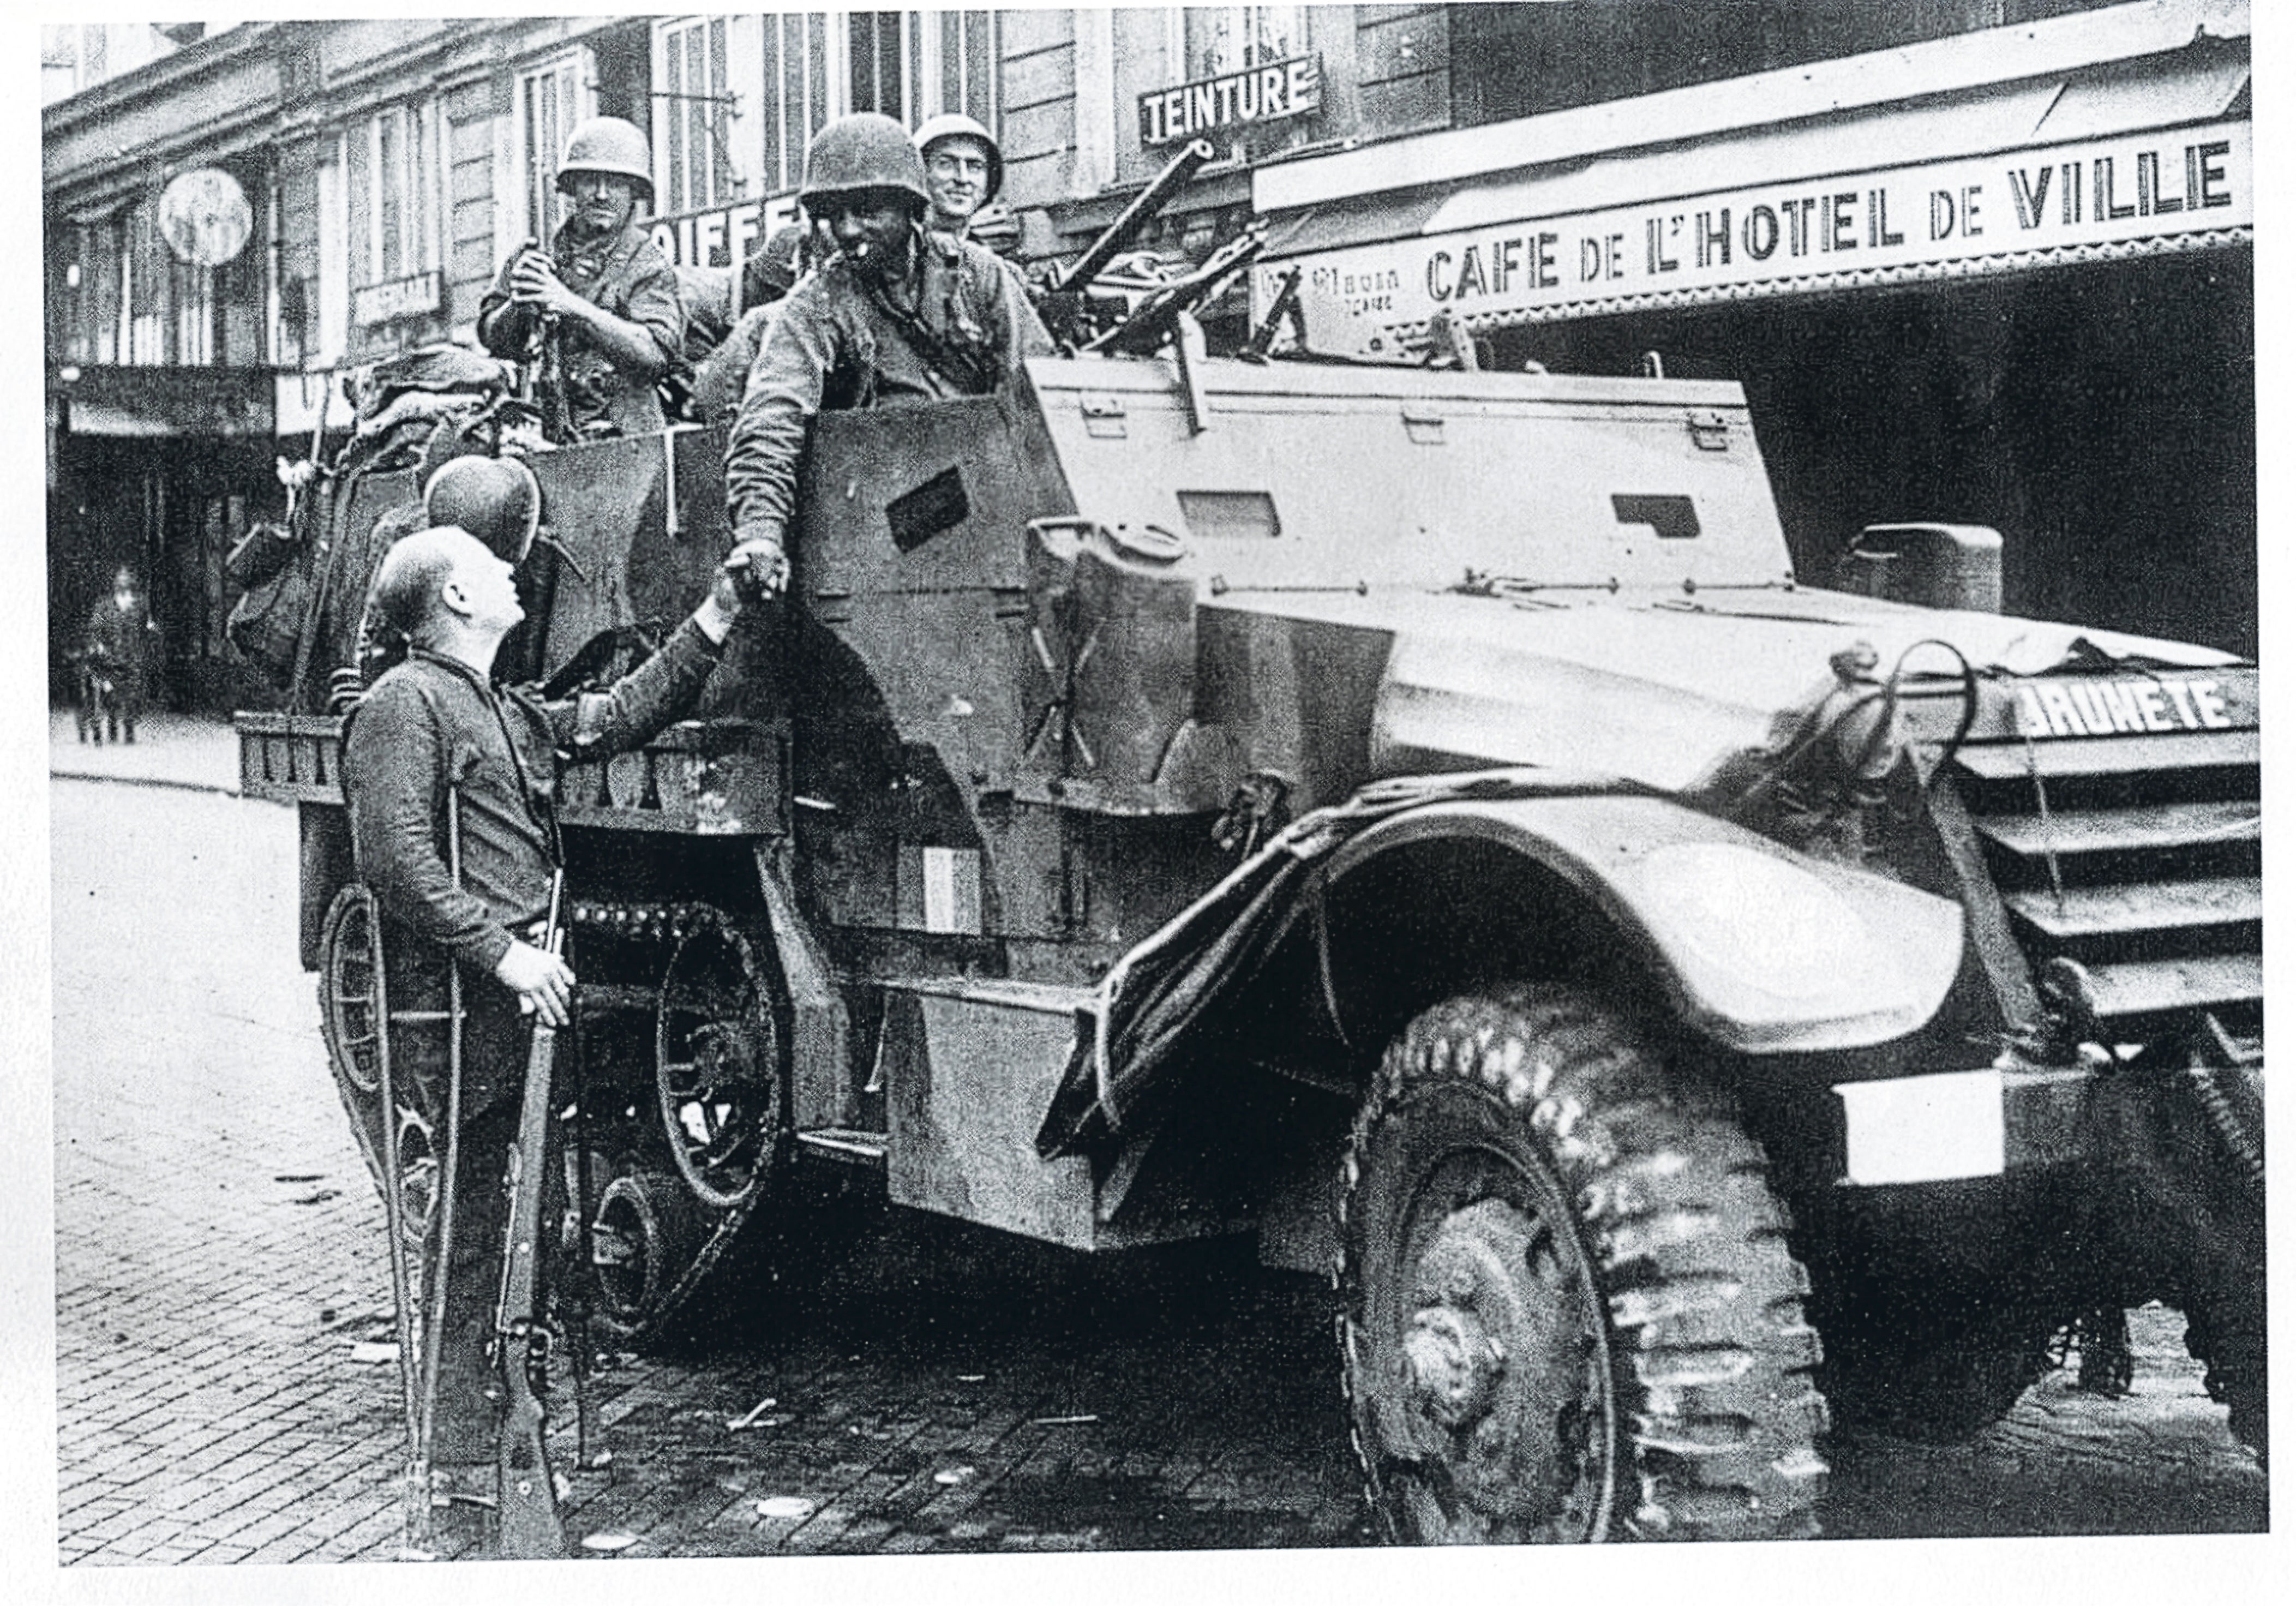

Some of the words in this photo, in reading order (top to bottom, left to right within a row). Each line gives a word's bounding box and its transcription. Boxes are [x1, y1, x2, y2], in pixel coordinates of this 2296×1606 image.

[1145, 61, 1316, 142] TEINTURE
[1426, 232, 1558, 302] CAFE
[1581, 233, 1624, 282] DE
[1646, 188, 1904, 274] L'HOTEL
[1929, 185, 1983, 241] DE
[2007, 140, 2232, 230] VILLE
